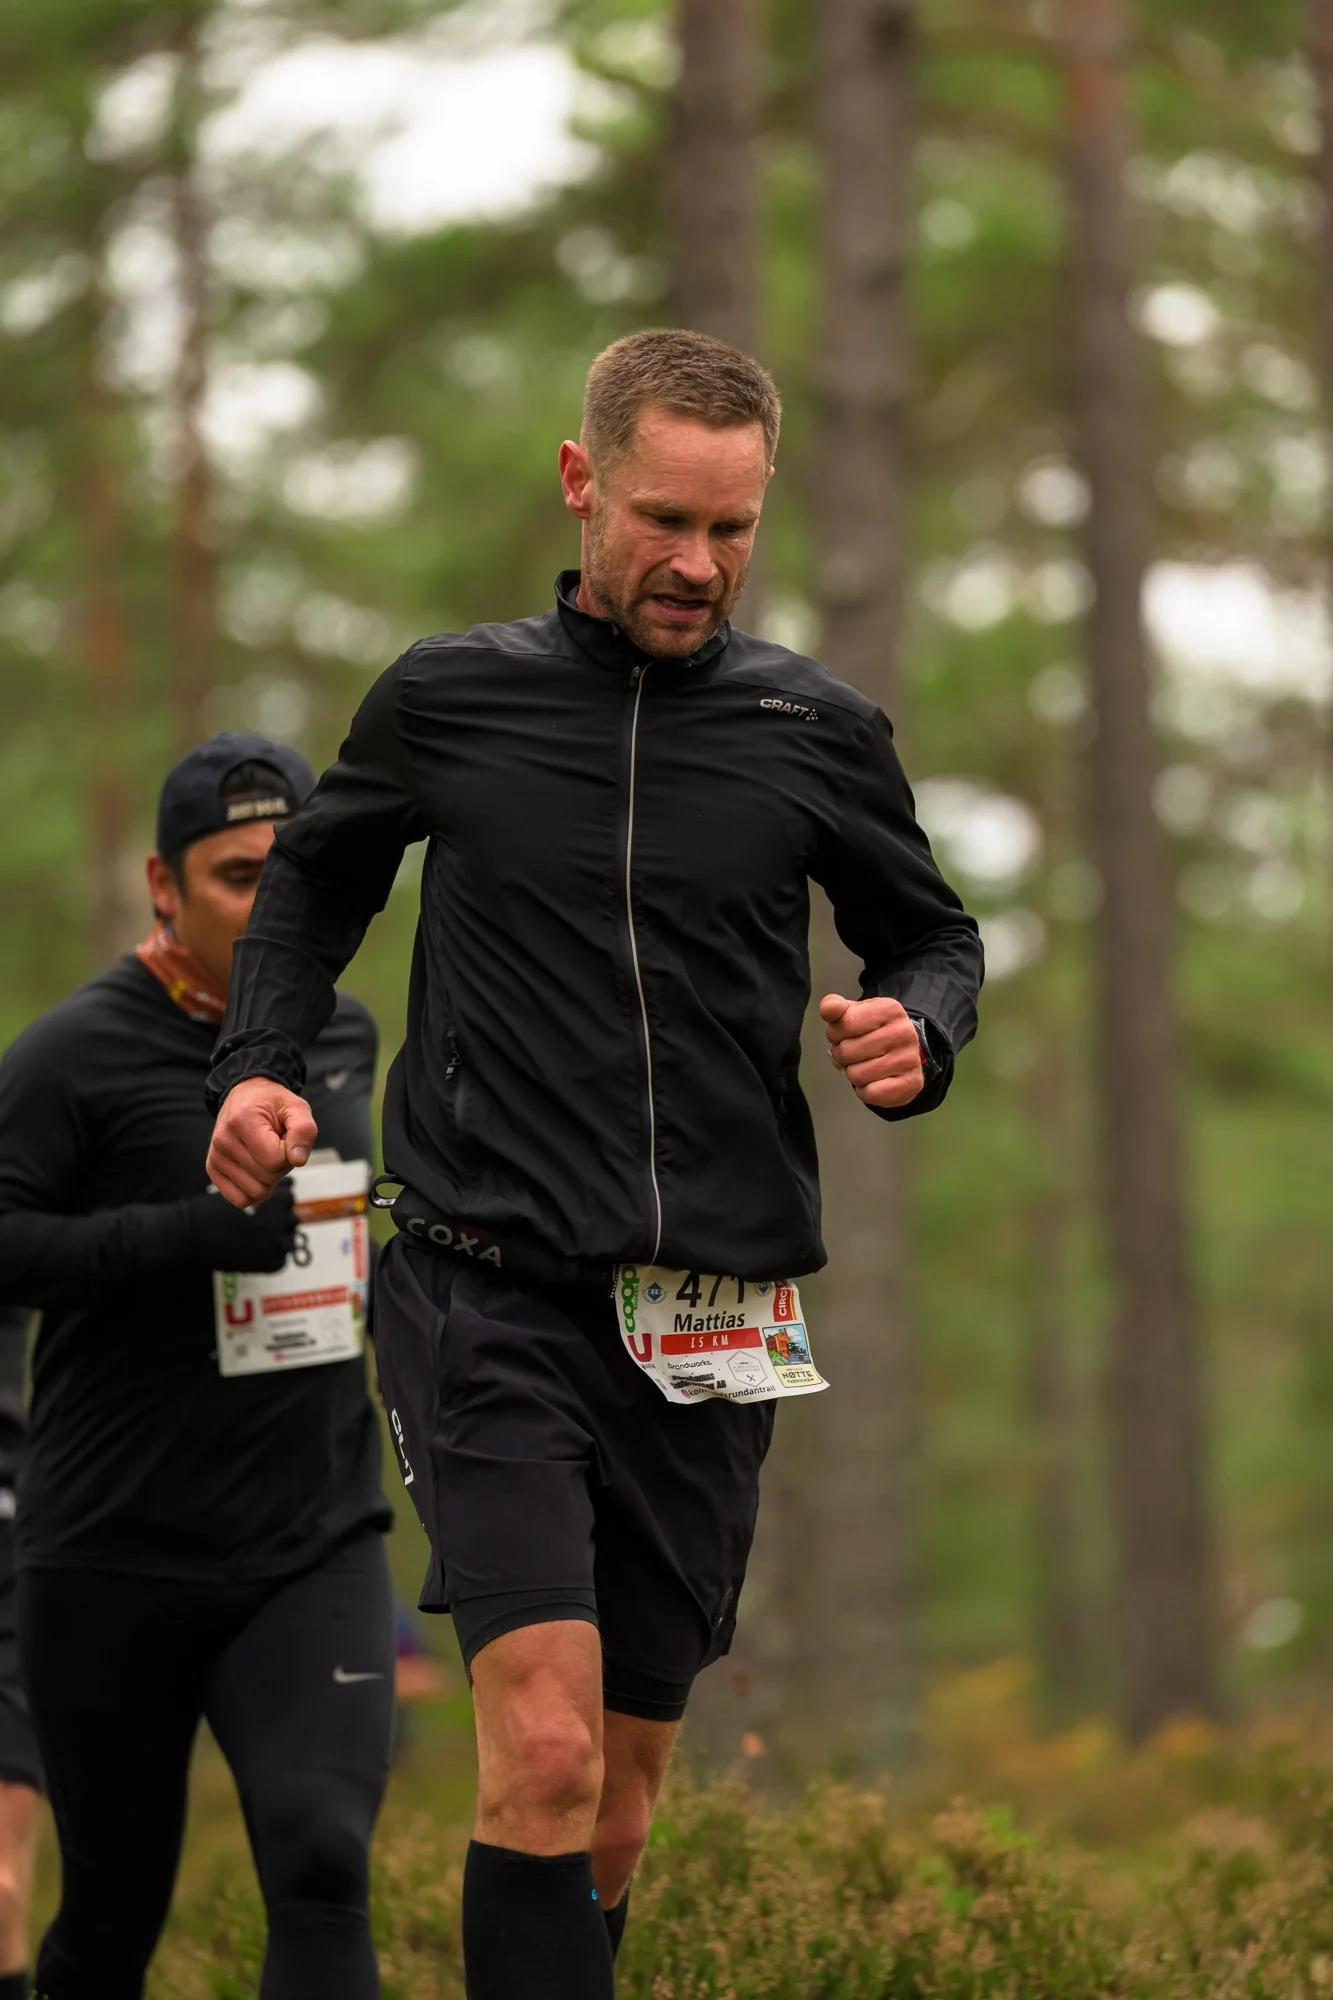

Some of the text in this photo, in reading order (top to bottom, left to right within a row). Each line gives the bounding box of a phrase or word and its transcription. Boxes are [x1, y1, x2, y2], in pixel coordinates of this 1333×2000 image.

[760, 699, 809, 717] CRAFT
[406, 1217, 502, 1268] COXA
[621, 1265, 640, 1333] coop
[676, 1268, 745, 1308] 471
[778, 1287, 788, 1317] CIRC
[674, 1310, 746, 1332] Mattias
[690, 1334, 729, 1348] 15 KM
[782, 1370, 813, 1379] NØTTE
